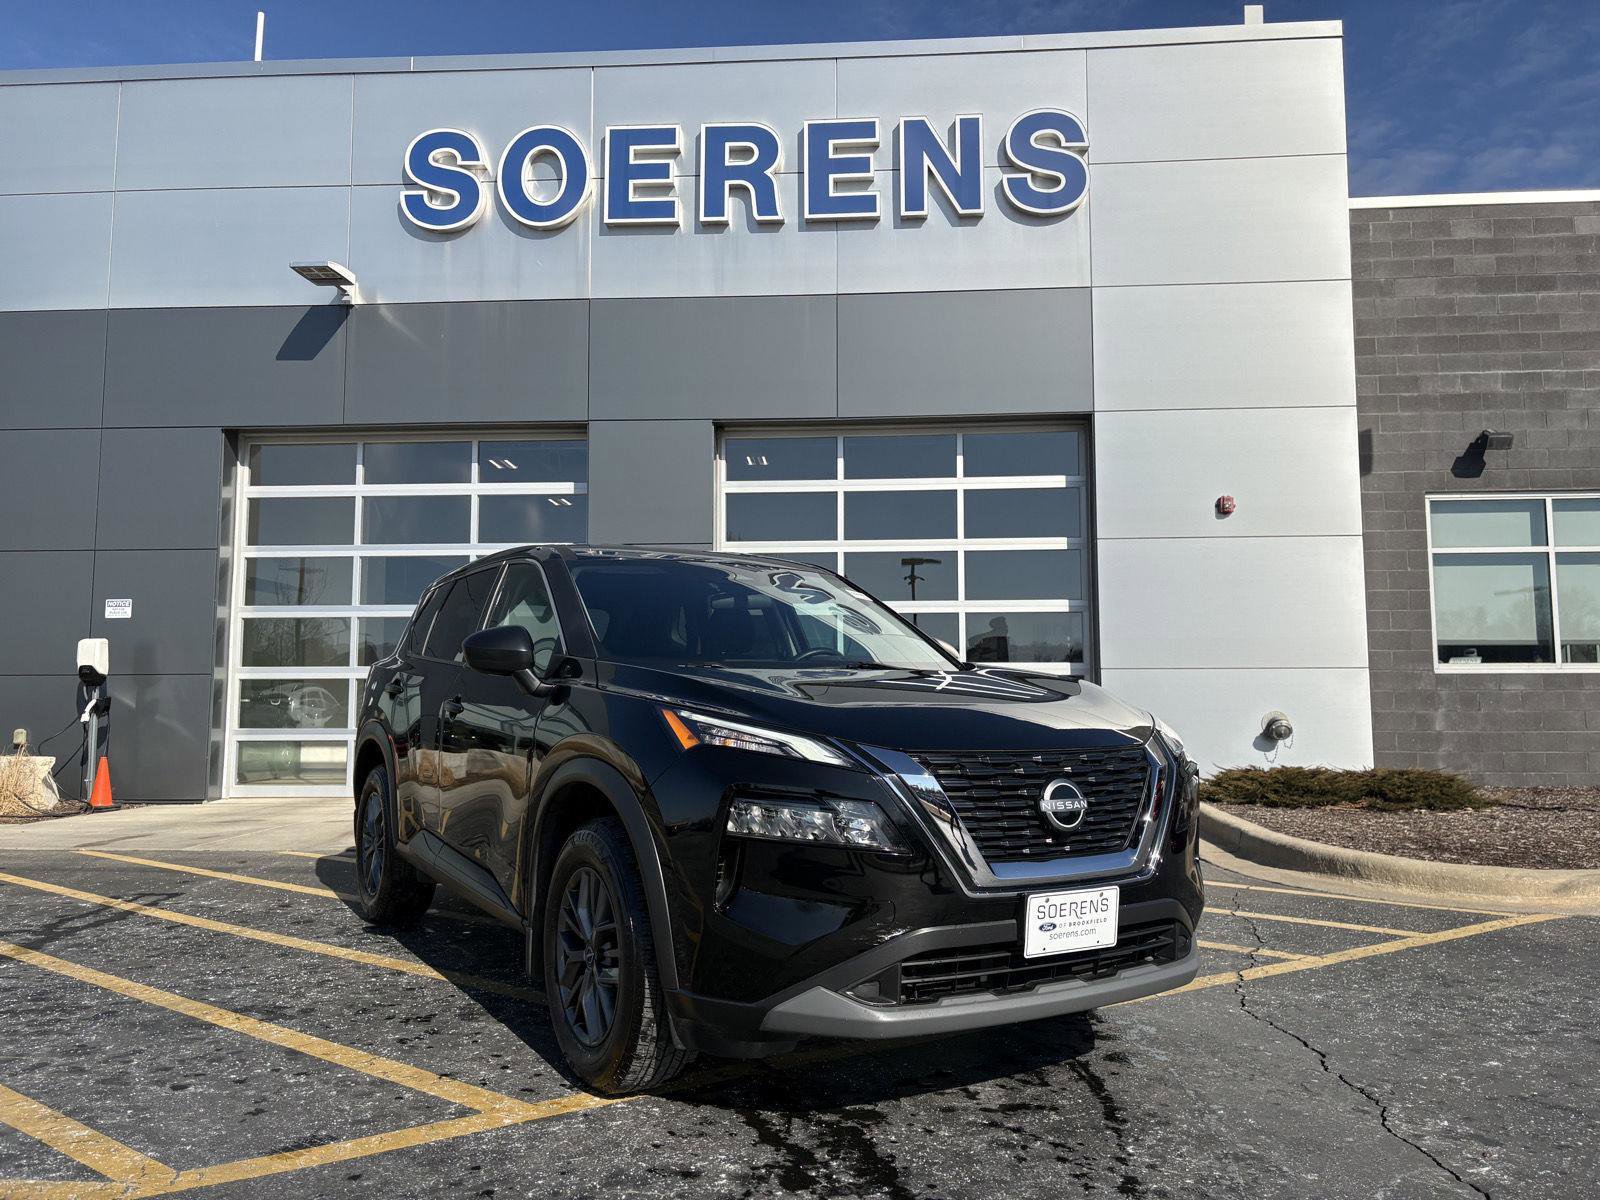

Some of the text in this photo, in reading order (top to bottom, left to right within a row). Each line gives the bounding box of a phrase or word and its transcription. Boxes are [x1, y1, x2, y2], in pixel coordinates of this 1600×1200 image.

[400, 108, 1091, 231] SOERENS
[1042, 800, 1087, 810] NISSAN
[1037, 898, 1109, 919] SOERENS
[1049, 928, 1097, 940] soerens.com
